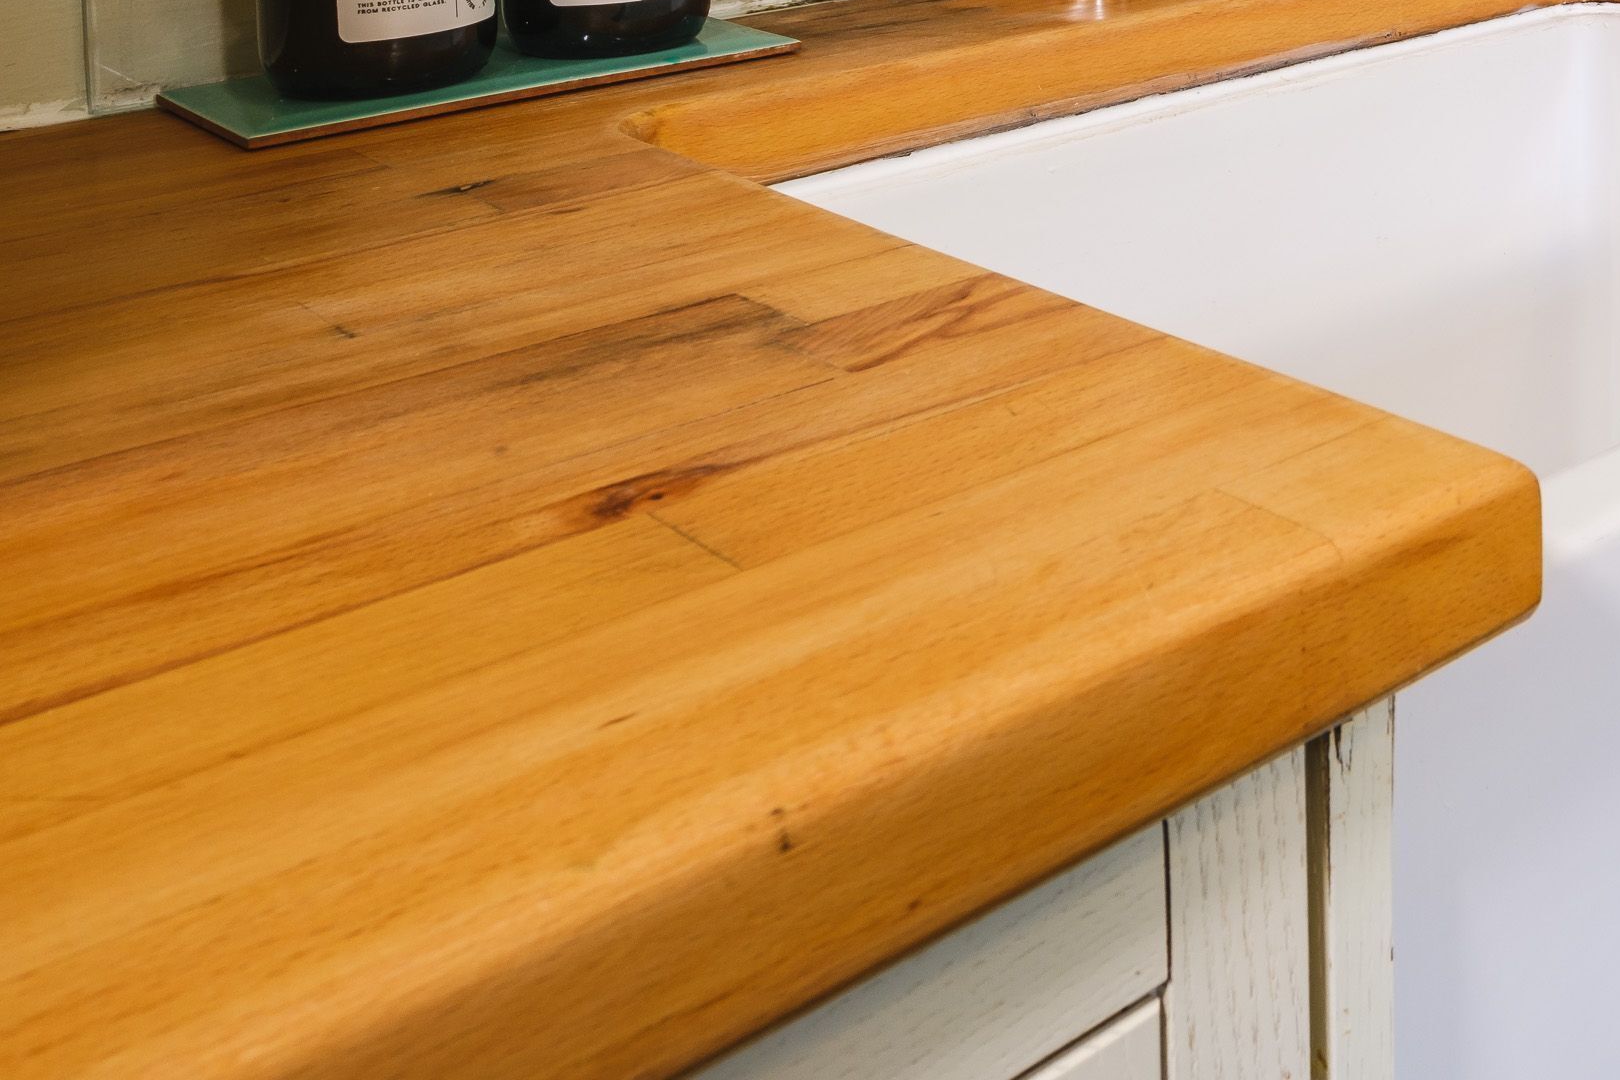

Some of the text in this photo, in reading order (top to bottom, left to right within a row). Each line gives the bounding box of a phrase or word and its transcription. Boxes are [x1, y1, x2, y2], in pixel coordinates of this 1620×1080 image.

[357, 0, 447, 15] FROM RECYCLED GLASS.
[377, 0, 404, 7] BOTTLE
